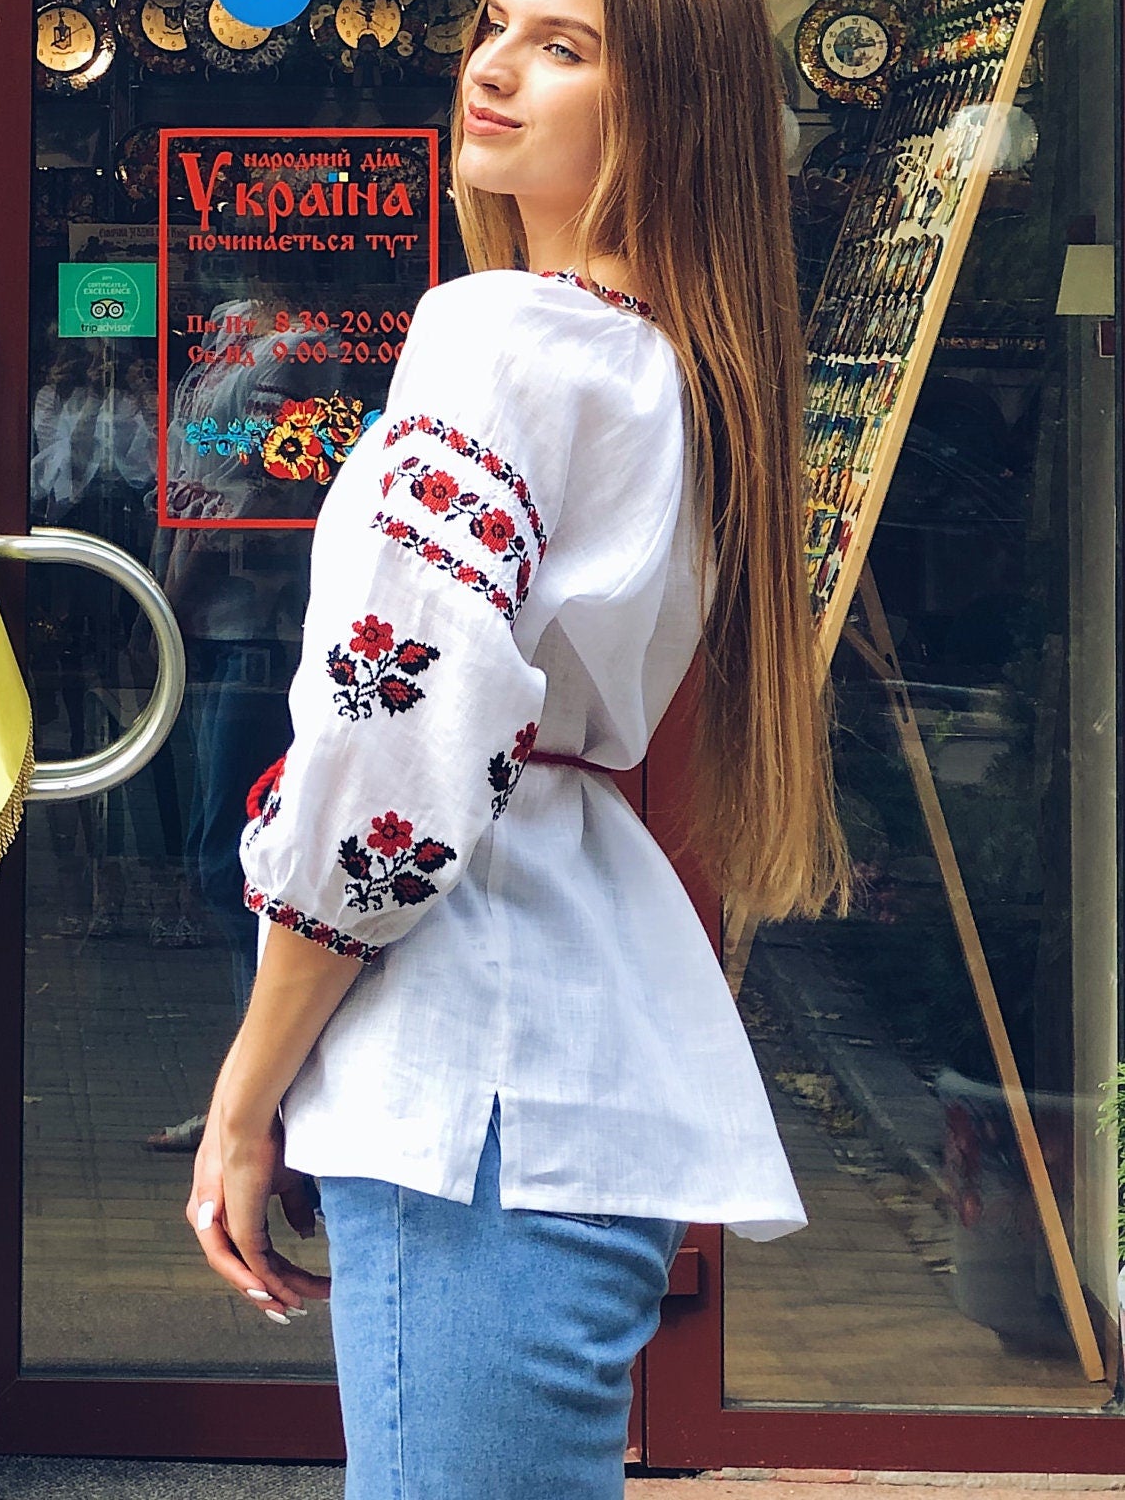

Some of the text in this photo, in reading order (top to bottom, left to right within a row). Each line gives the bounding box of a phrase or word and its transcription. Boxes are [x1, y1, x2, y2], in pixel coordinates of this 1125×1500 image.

[243, 147, 403, 172] народний дім
[178, 151, 414, 234] Україна
[188, 233, 419, 259] починається тут
[81, 322, 132, 334] tripadvisor
[186, 310, 411, 334] Пн-Пт 8.30-20.00
